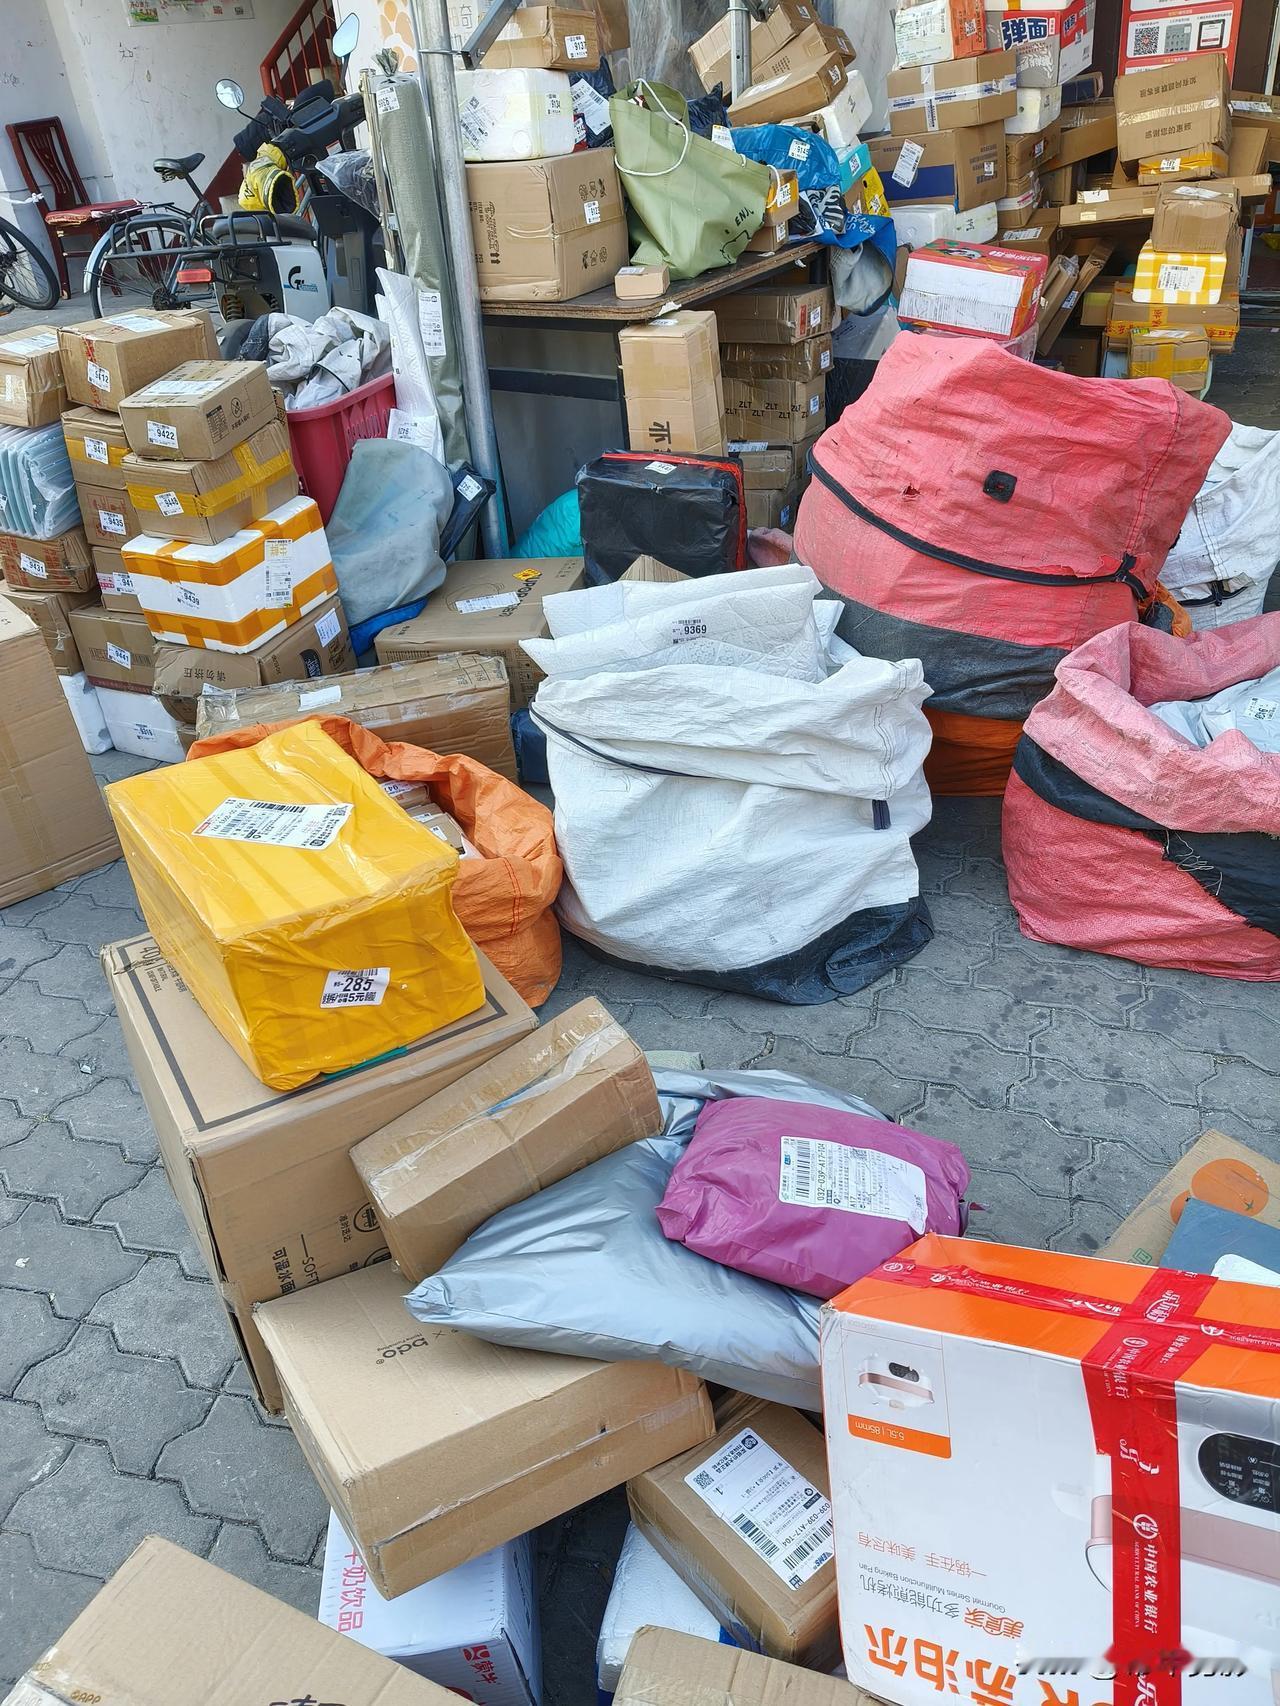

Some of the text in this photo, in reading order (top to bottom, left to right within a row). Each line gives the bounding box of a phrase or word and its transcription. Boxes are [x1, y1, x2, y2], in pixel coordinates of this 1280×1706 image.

[1002, 18, 1048, 48] 弹面
[1145, 122, 1193, 139] 感谢您的惠顾
[156, 427, 175, 441] 9422
[108, 516, 124, 528] 9435
[29, 561, 44, 574] 9431
[184, 592, 200, 606] 9439
[684, 624, 707, 635] 9369
[183, 667, 226, 682] 请勿挤压
[343, 977, 375, 992] 285
[271, 1247, 297, 1295] 可湿水面
[302, 1256, 321, 1285] SOFT
[1114, 1348, 1141, 1400] 中国农业银行
[855, 1421, 905, 1441] 5.5L 85mm
[783, 1502, 831, 1548] 039-039-A17-T04
[858, 1532, 988, 1578] 一锅在手 美味尽有
[858, 1562, 1006, 1614] Gourmet Series Multifunction Baking Pan
[1143, 1544, 1158, 1634] 中国农业银行
[859, 1573, 1025, 1640] 美食家 多功能煎烤机
[471, 1660, 499, 1685] 蒙牛
[863, 1623, 1017, 1706] 苏泊尔
